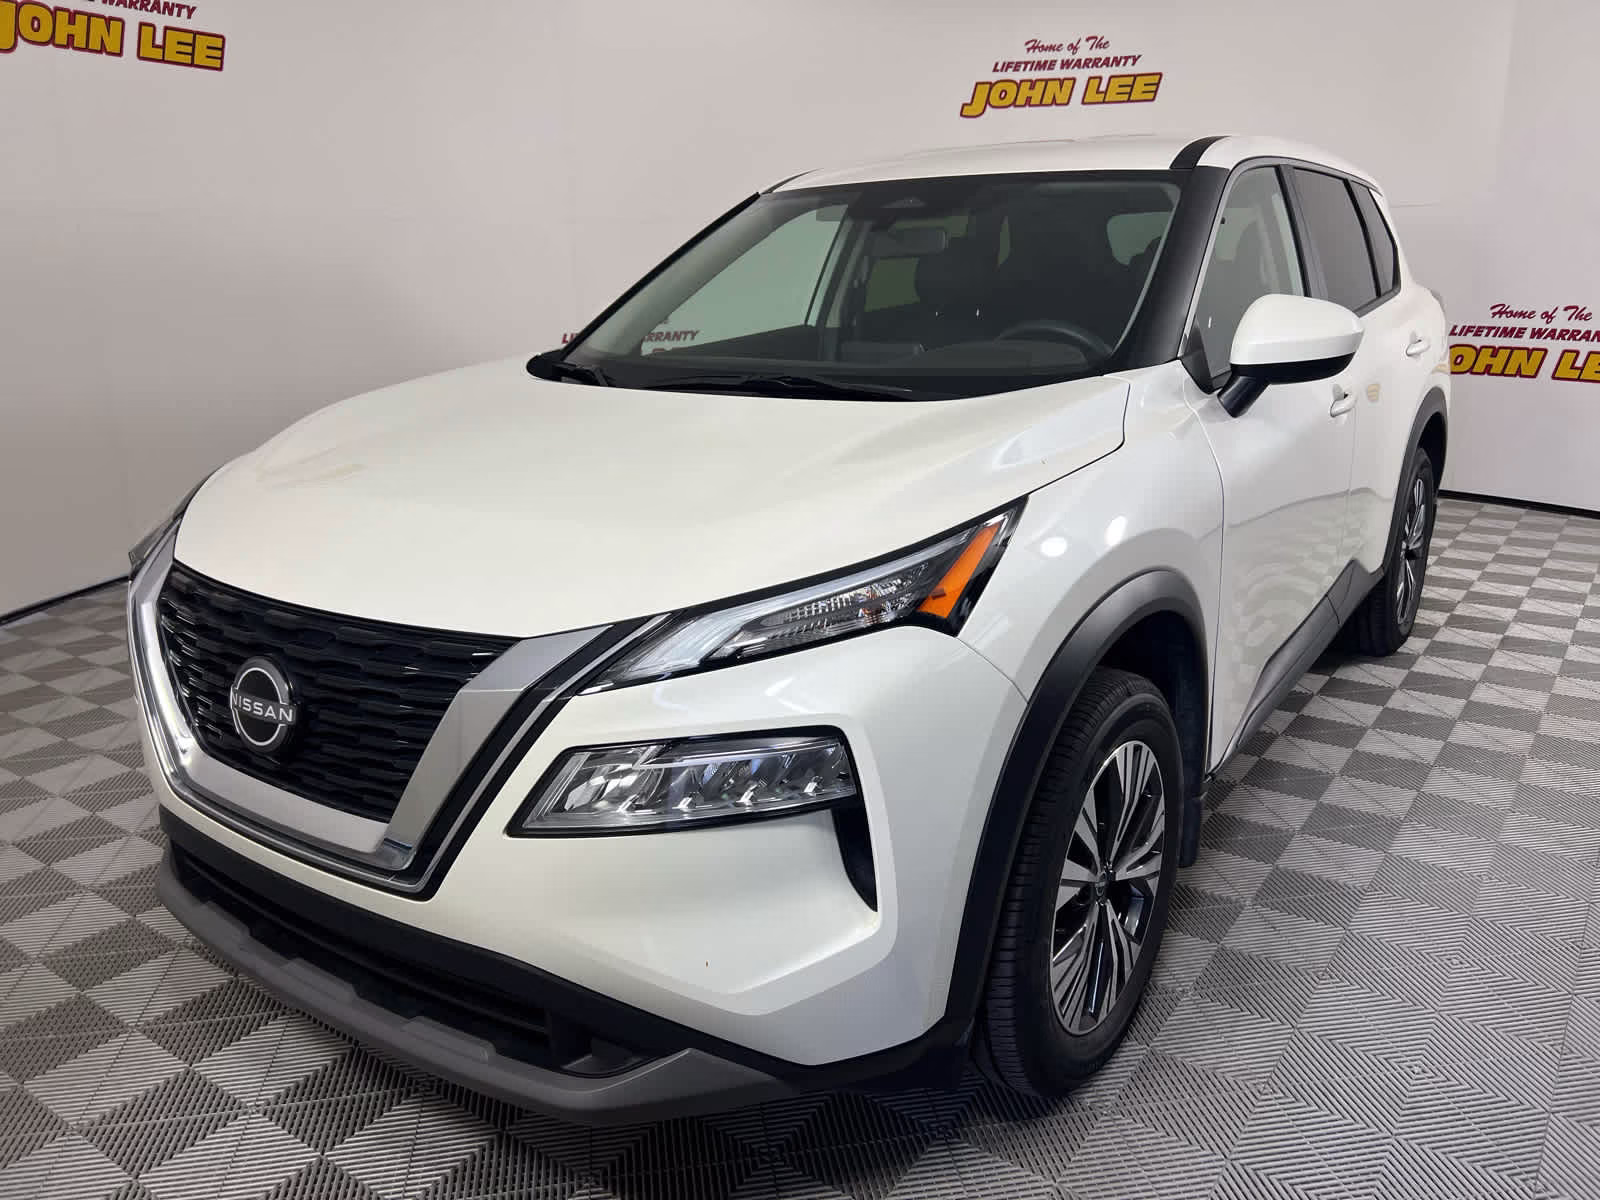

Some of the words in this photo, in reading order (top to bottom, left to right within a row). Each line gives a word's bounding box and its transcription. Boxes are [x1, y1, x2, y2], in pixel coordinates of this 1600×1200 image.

[136, 21, 226, 72] LEE
[1024, 38, 1064, 54] Home
[1067, 37, 1082, 56] of
[1085, 35, 1110, 51] The
[992, 59, 1057, 73] LIFETIME
[1060, 54, 1142, 70] WARRANTY
[960, 77, 1077, 119] JOHN
[1081, 72, 1163, 105] LEE
[1489, 303, 1537, 320] Home
[1540, 306, 1559, 325] of
[1563, 305, 1593, 322] The
[1449, 324, 1528, 339] LIFETIME
[1529, 327, 1600, 343] WARRAN
[1449, 344, 1549, 379] OHN
[1551, 349, 1600, 384] LE
[230, 692, 293, 722] NISSAN
